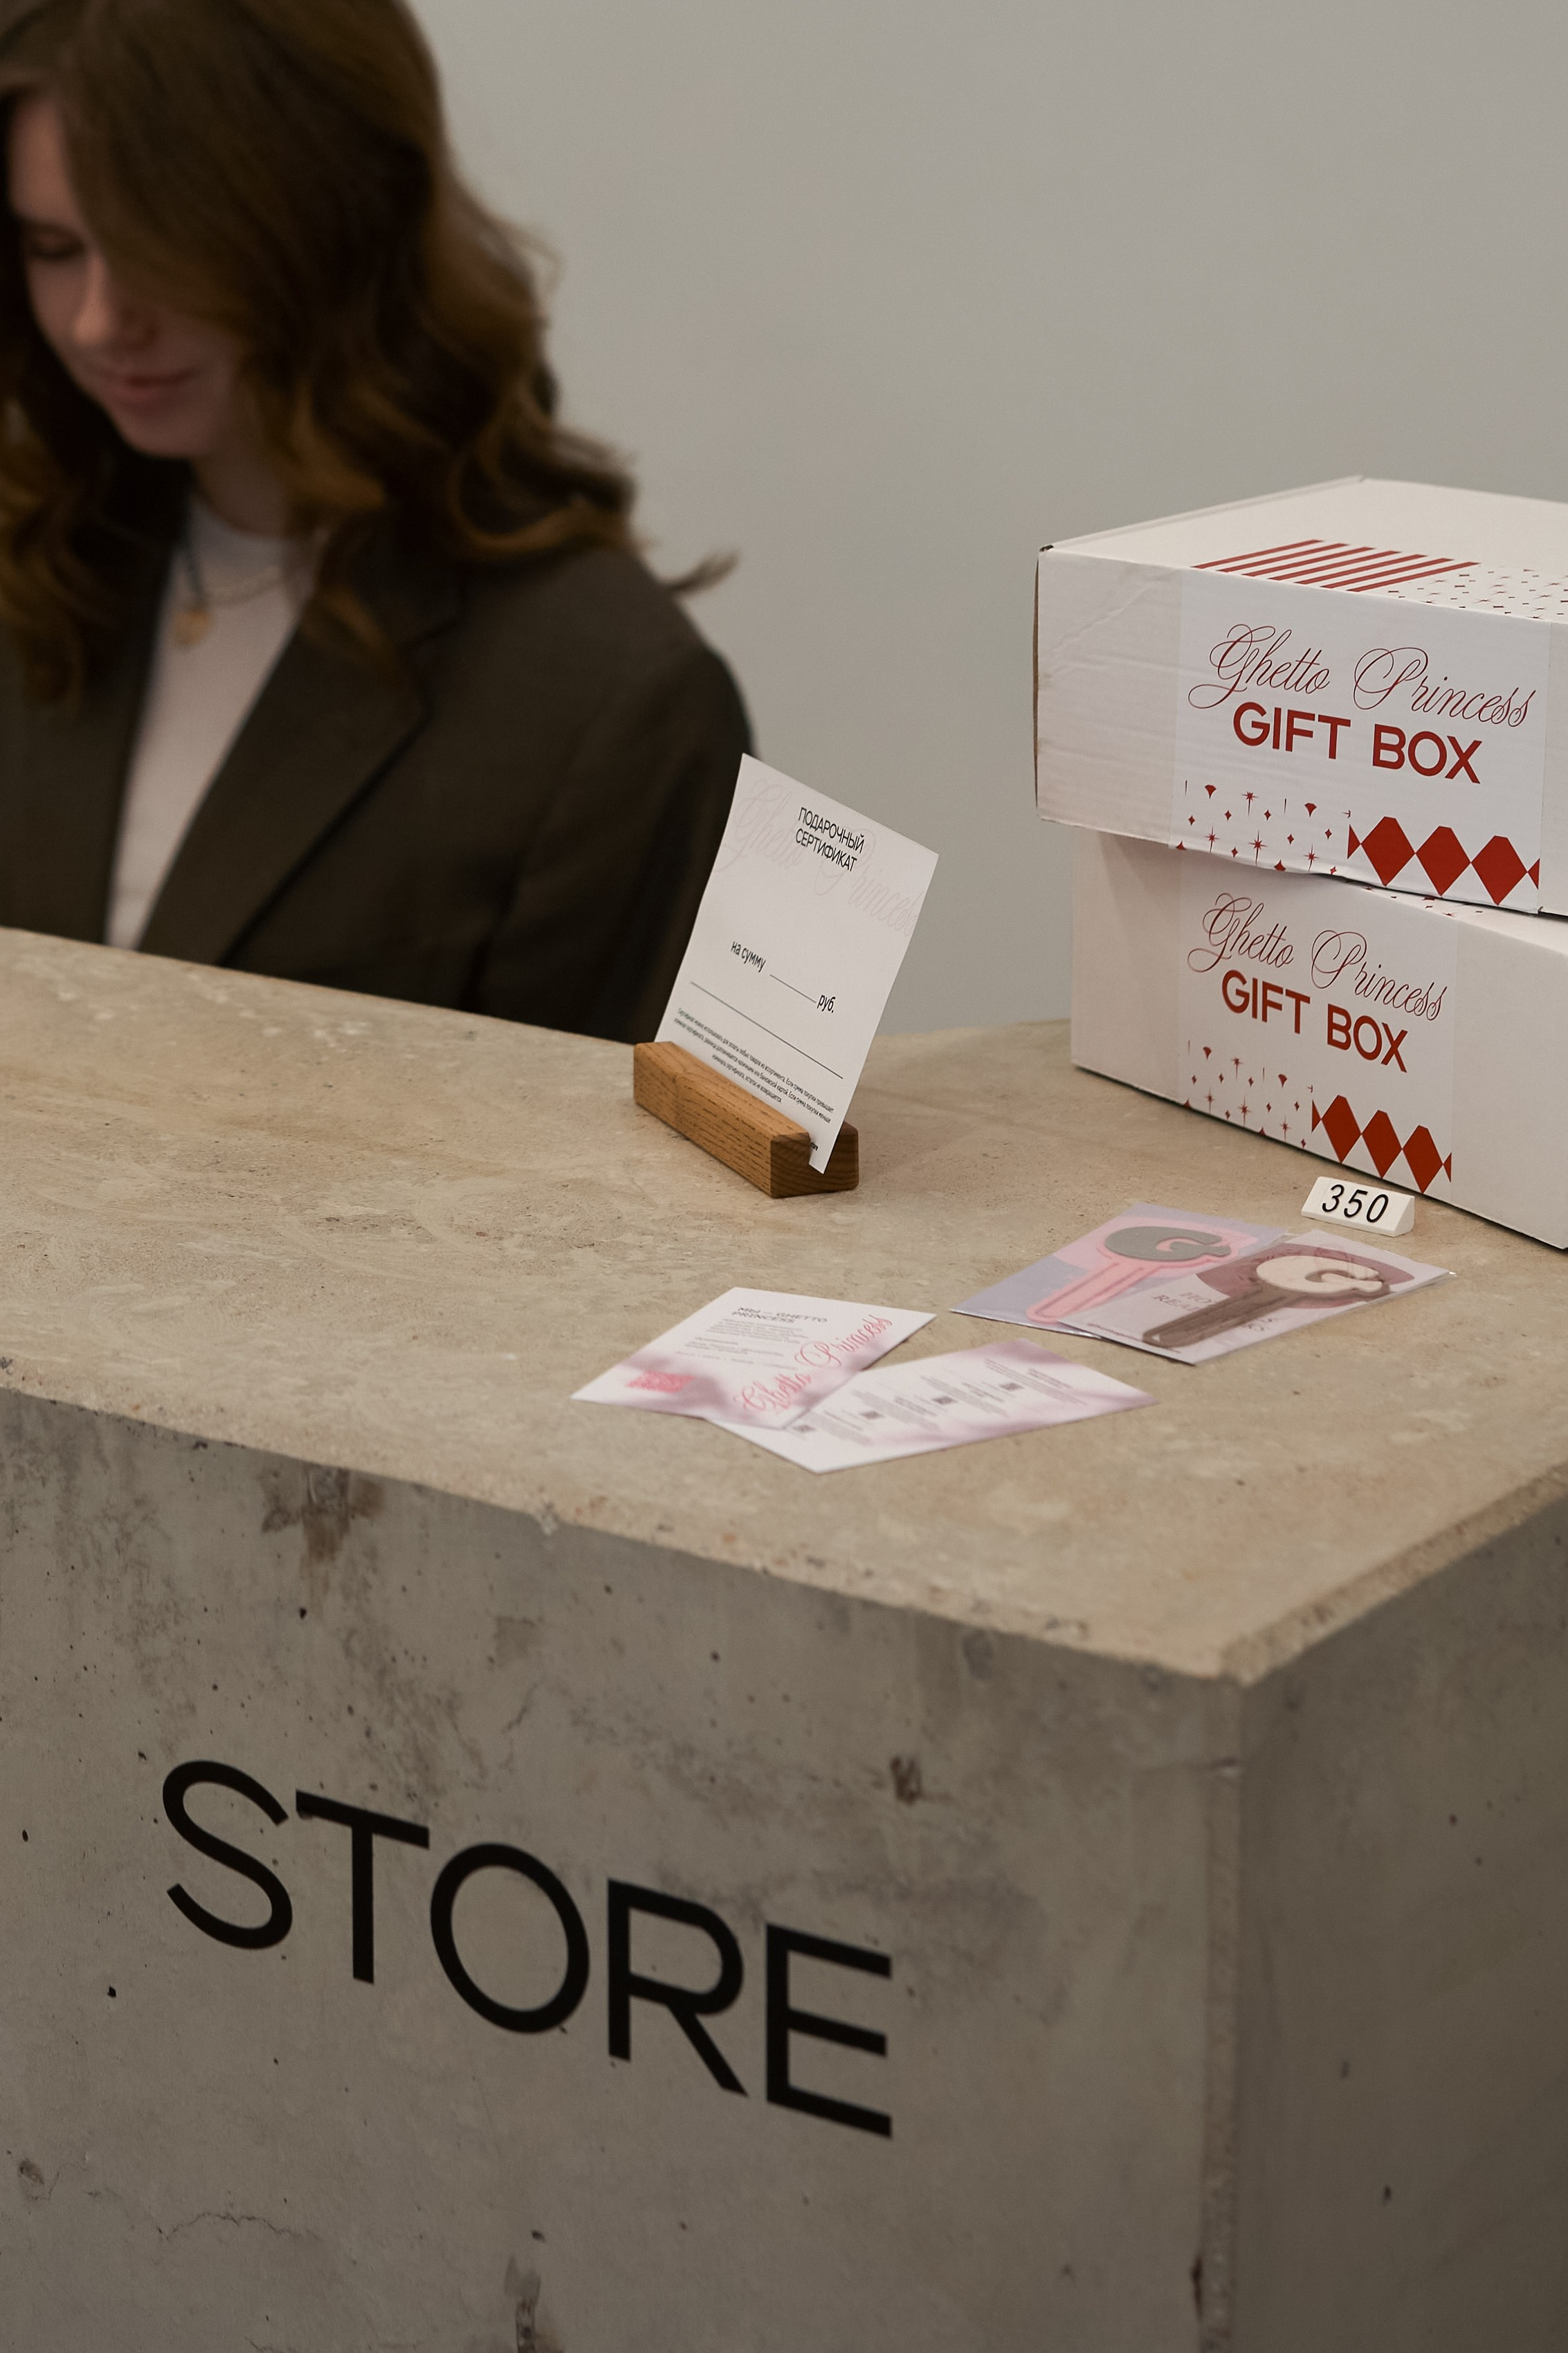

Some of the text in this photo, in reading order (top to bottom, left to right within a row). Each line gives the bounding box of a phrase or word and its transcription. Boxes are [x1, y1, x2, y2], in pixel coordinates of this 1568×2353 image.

[1188, 624, 1536, 727] Ghetto Princess
[1232, 701, 1483, 784] GIFT BOX
[795, 828, 857, 873] СЕРТИФИКАТ
[798, 806, 864, 854] ПОДАРОЧНЫЙ
[731, 940, 836, 1013] на сумму руб.
[1187, 893, 1448, 1021] Ghetto Princess
[1222, 970, 1408, 1073] GIFT BOX
[1321, 1183, 1389, 1224] 350
[794, 1313, 894, 1368] Princess
[162, 1760, 893, 2140] STORE
